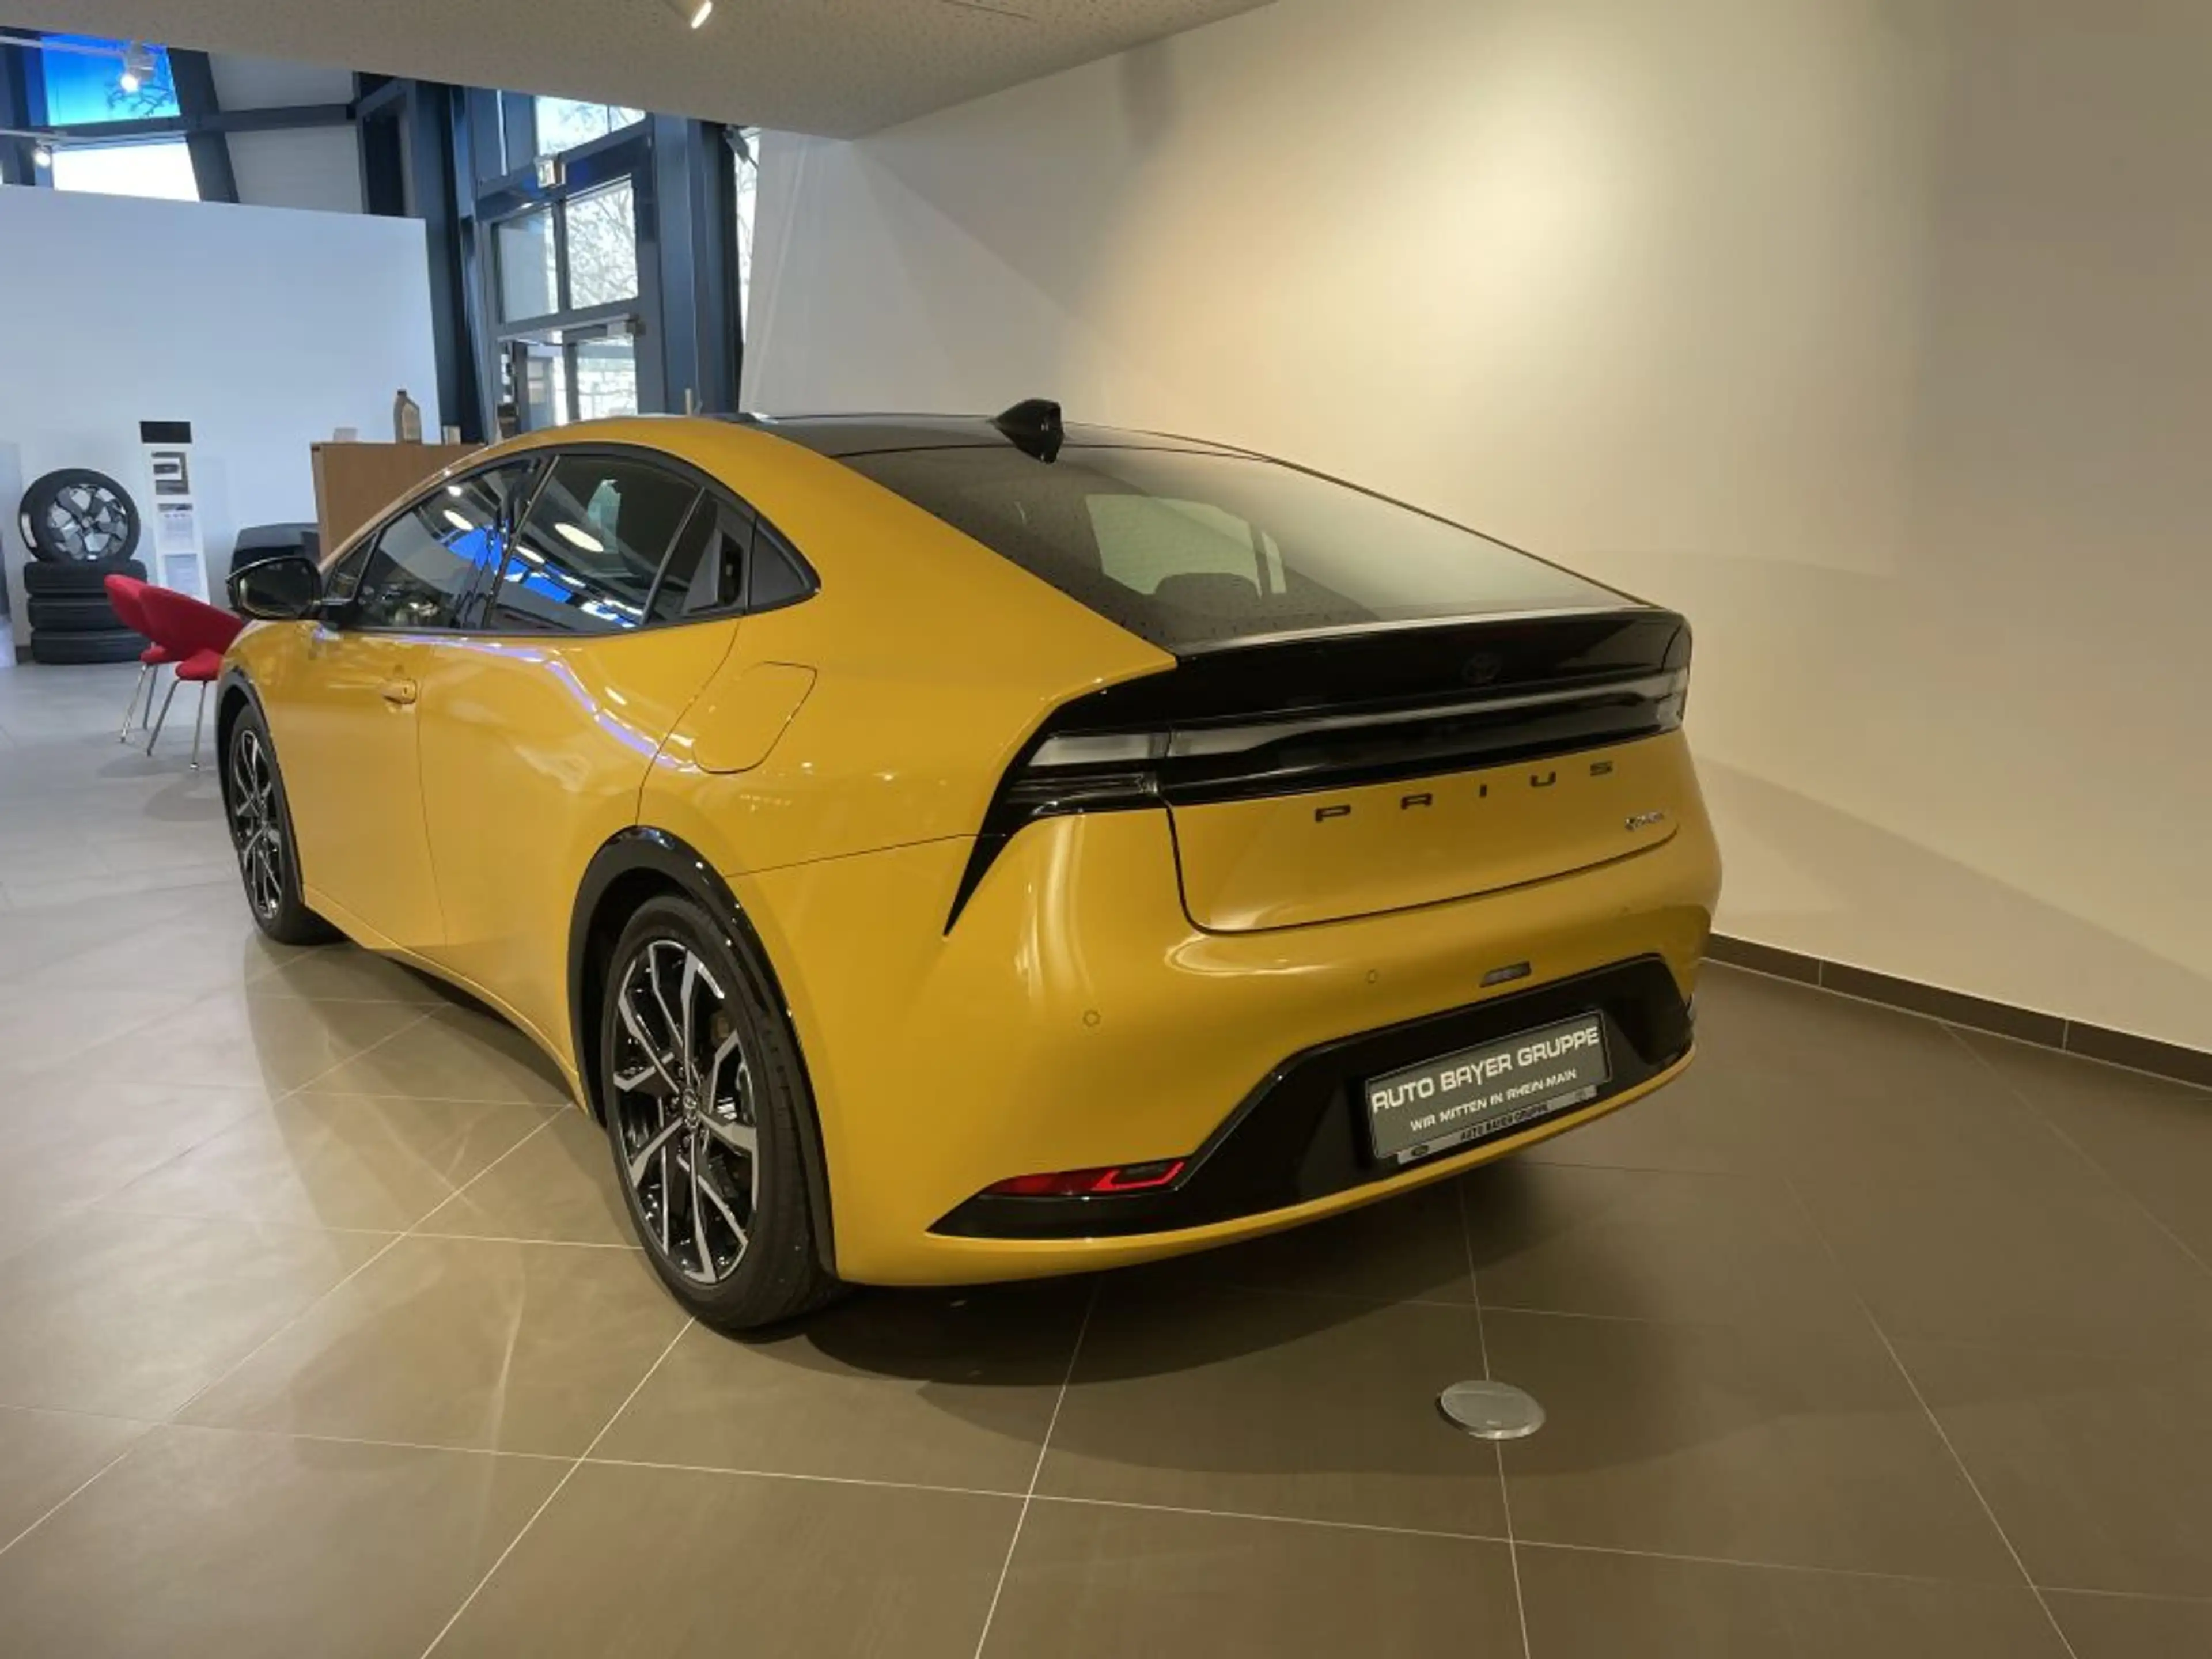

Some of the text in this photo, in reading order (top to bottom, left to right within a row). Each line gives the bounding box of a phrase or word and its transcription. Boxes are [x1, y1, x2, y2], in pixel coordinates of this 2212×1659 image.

[1315, 760, 1612, 823] PRIUS
[1371, 1026, 1599, 1114] AUTO BAYER GRUPPE
[1410, 1113, 1436, 1131] WIR
[1440, 1097, 1487, 1122] MITTEN
[1490, 1092, 1504, 1105] IN
